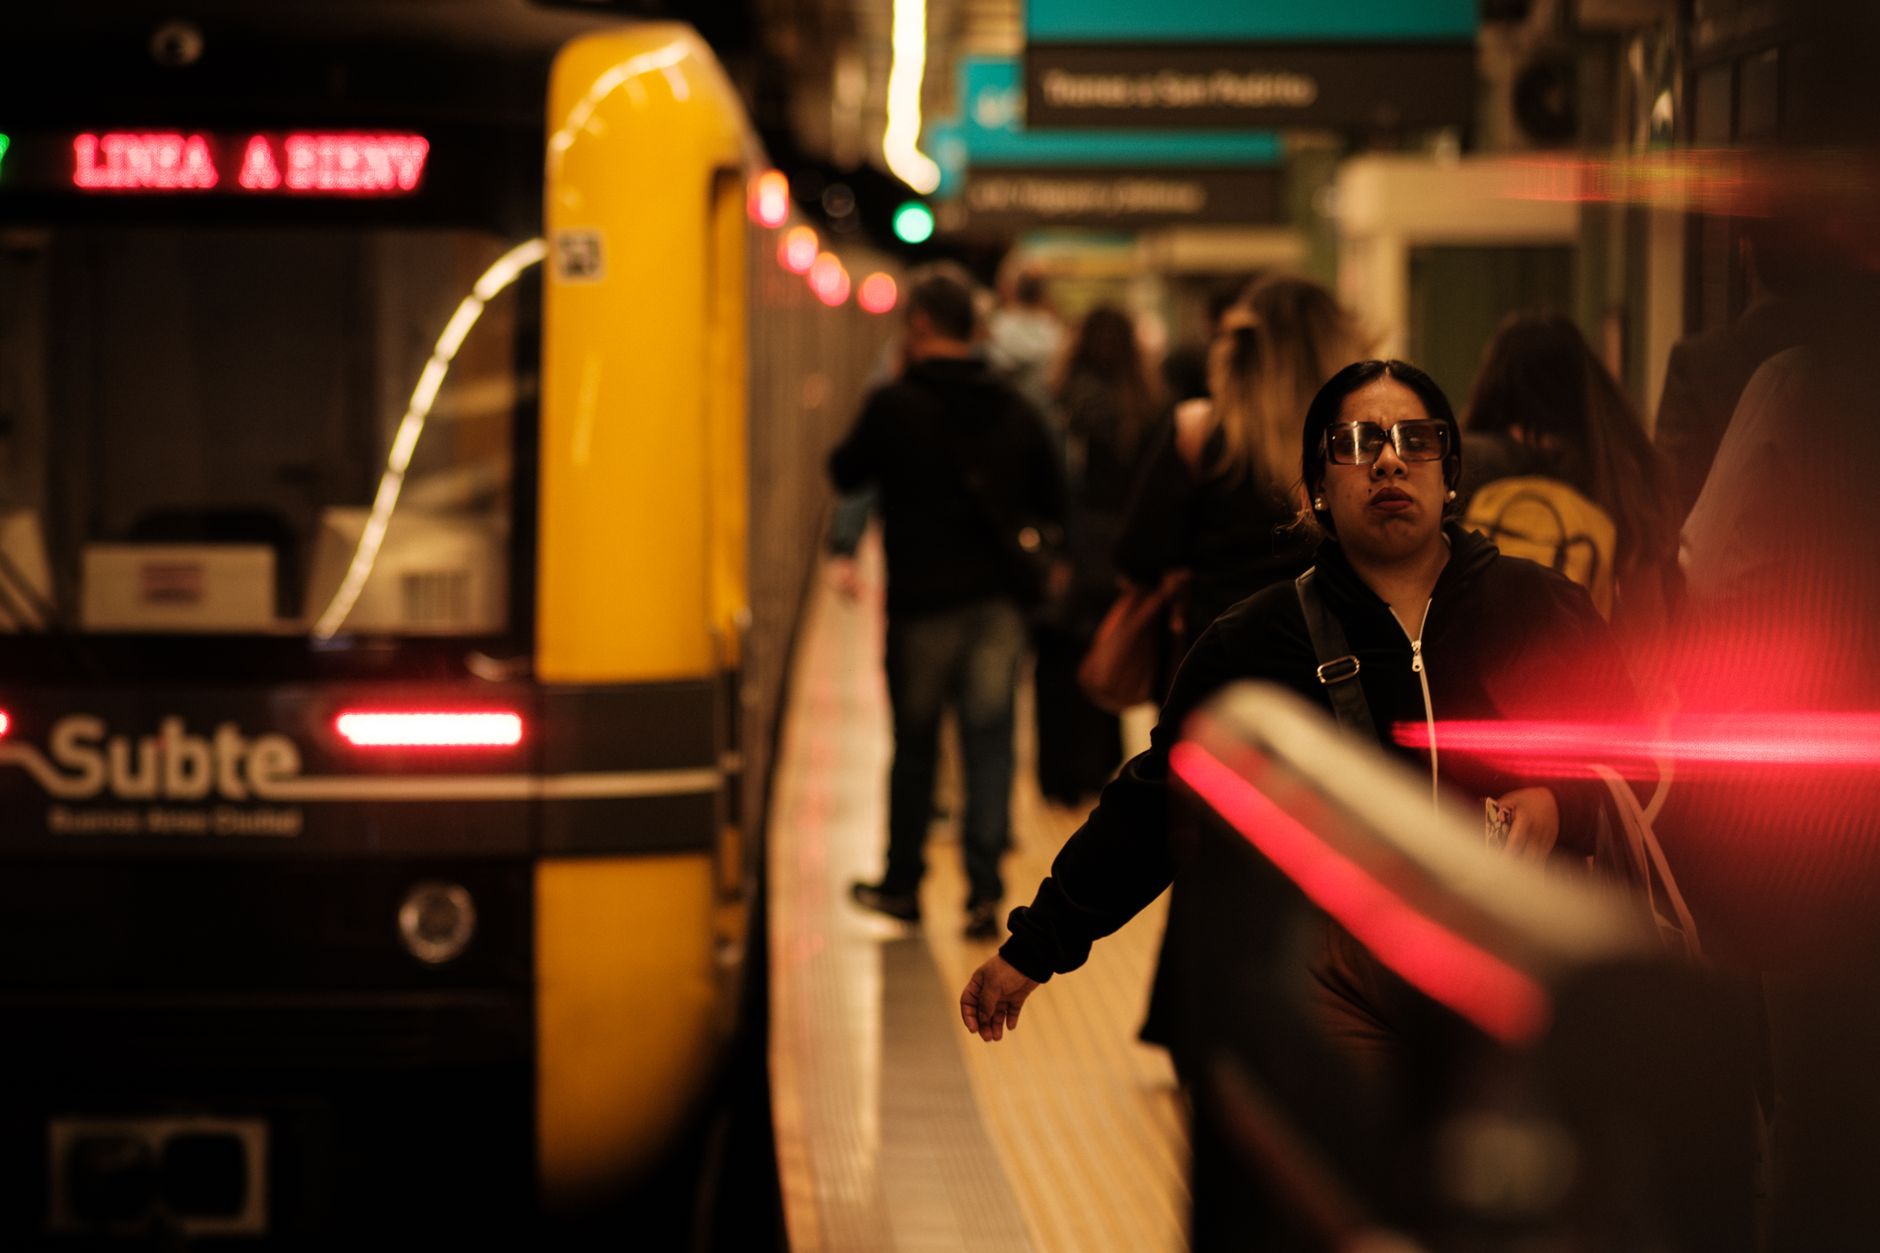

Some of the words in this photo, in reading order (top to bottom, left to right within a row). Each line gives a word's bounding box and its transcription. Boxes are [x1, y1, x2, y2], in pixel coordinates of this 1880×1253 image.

[73, 133, 219, 188] LINEA
[239, 134, 281, 188] A
[52, 717, 300, 799] Subte
